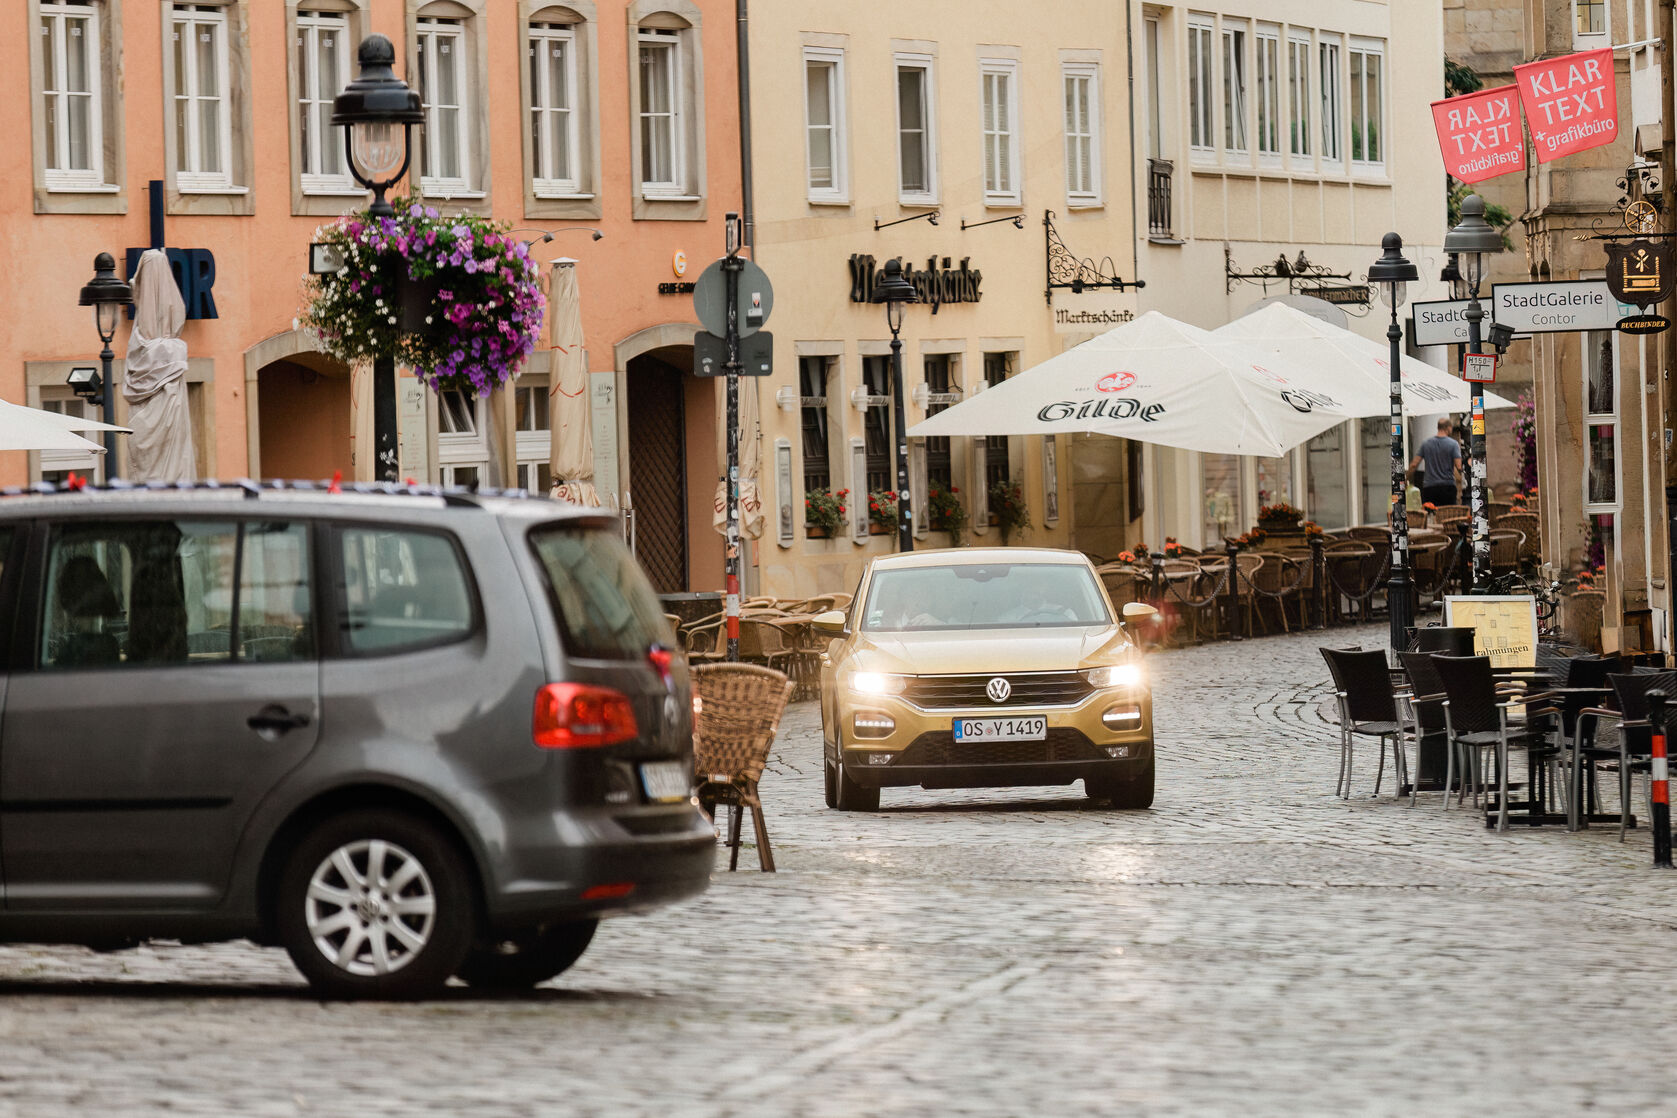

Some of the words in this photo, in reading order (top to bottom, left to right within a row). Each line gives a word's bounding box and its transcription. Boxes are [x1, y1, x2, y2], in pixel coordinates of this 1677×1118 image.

[1529, 59, 1602, 98] KLAR
[1538, 85, 1606, 125] TEXT
[1503, 291, 1603, 308] StadtGalerie
[1532, 313, 1576, 325] Contor
[1621, 320, 1666, 328] BUCHBINDER
[964, 722, 984, 736] OS
[994, 722, 1002, 736] Y
[1006, 720, 1043, 736] 1419
